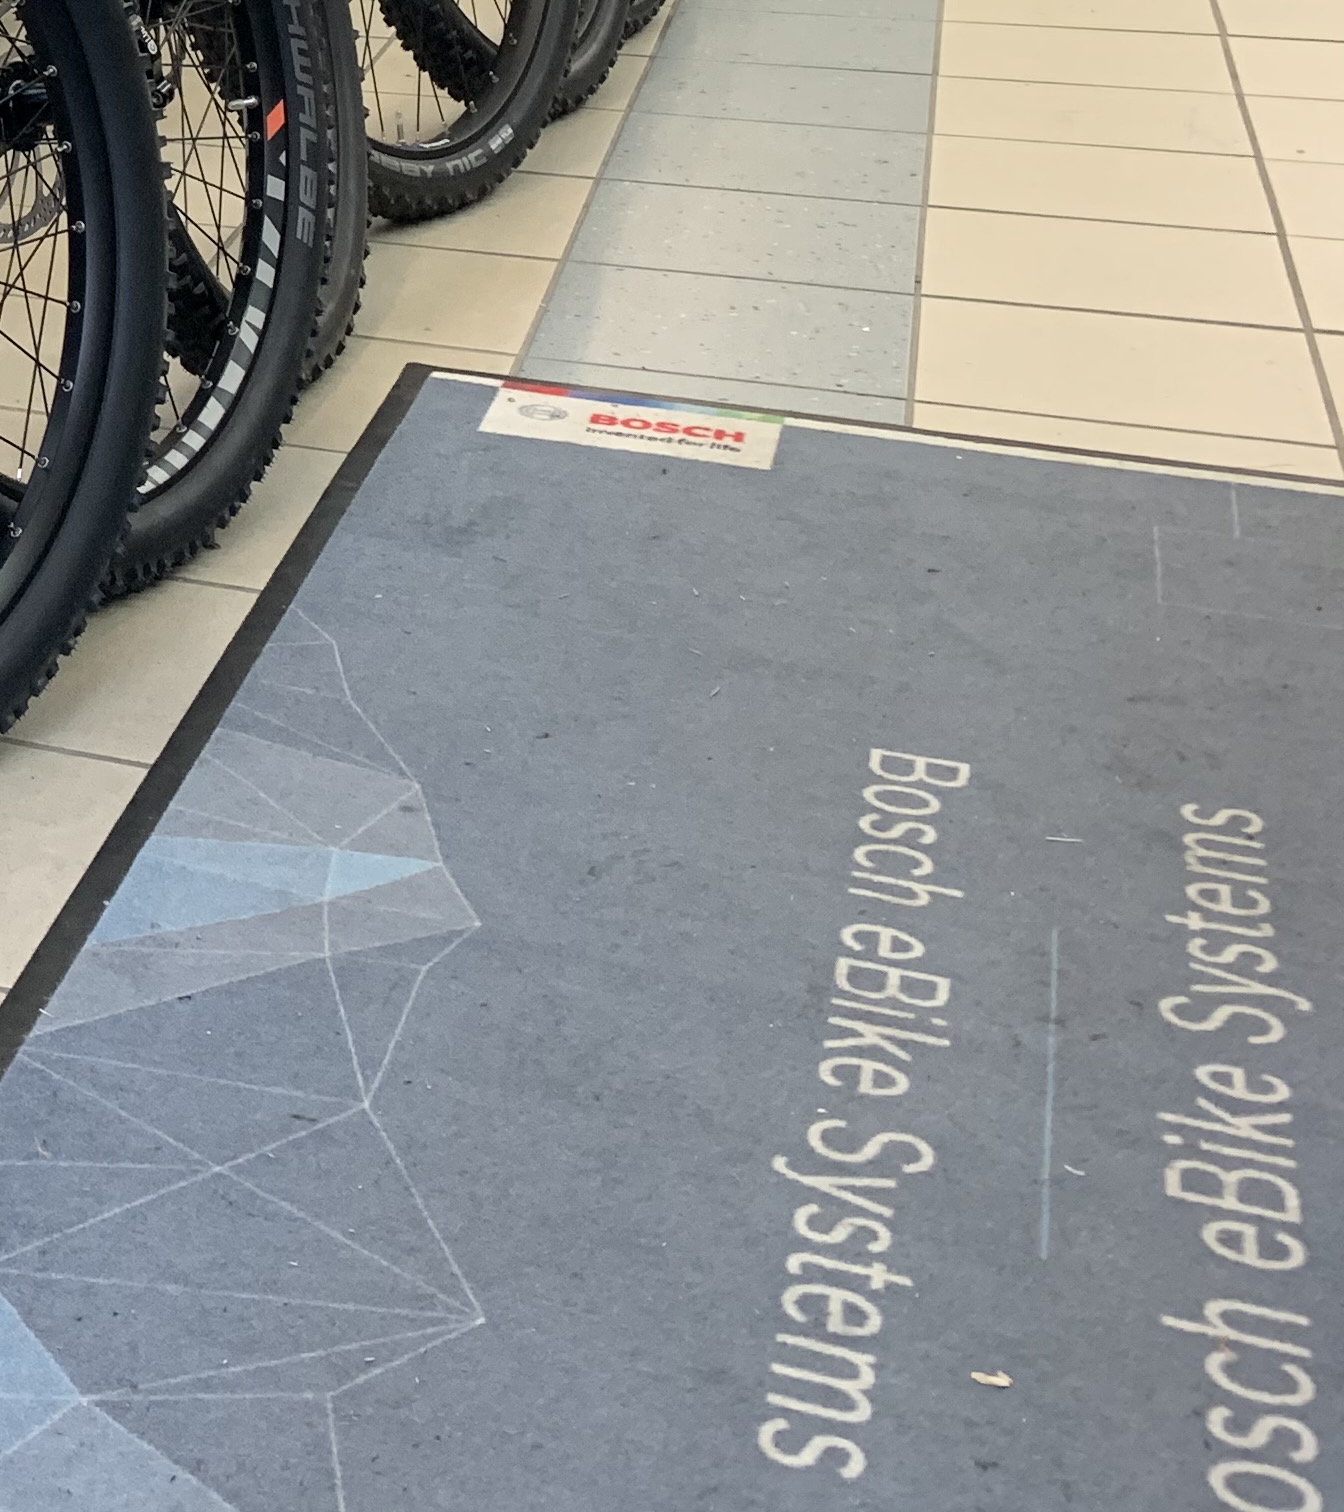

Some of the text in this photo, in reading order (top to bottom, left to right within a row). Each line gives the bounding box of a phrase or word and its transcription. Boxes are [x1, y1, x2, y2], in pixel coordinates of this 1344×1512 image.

[588, 413, 747, 444] BOSCH
[1159, 802, 1313, 1045] Systems
[757, 747, 971, 1479] Bosch eBike Systems
[1157, 1061, 1307, 1272] eBike
